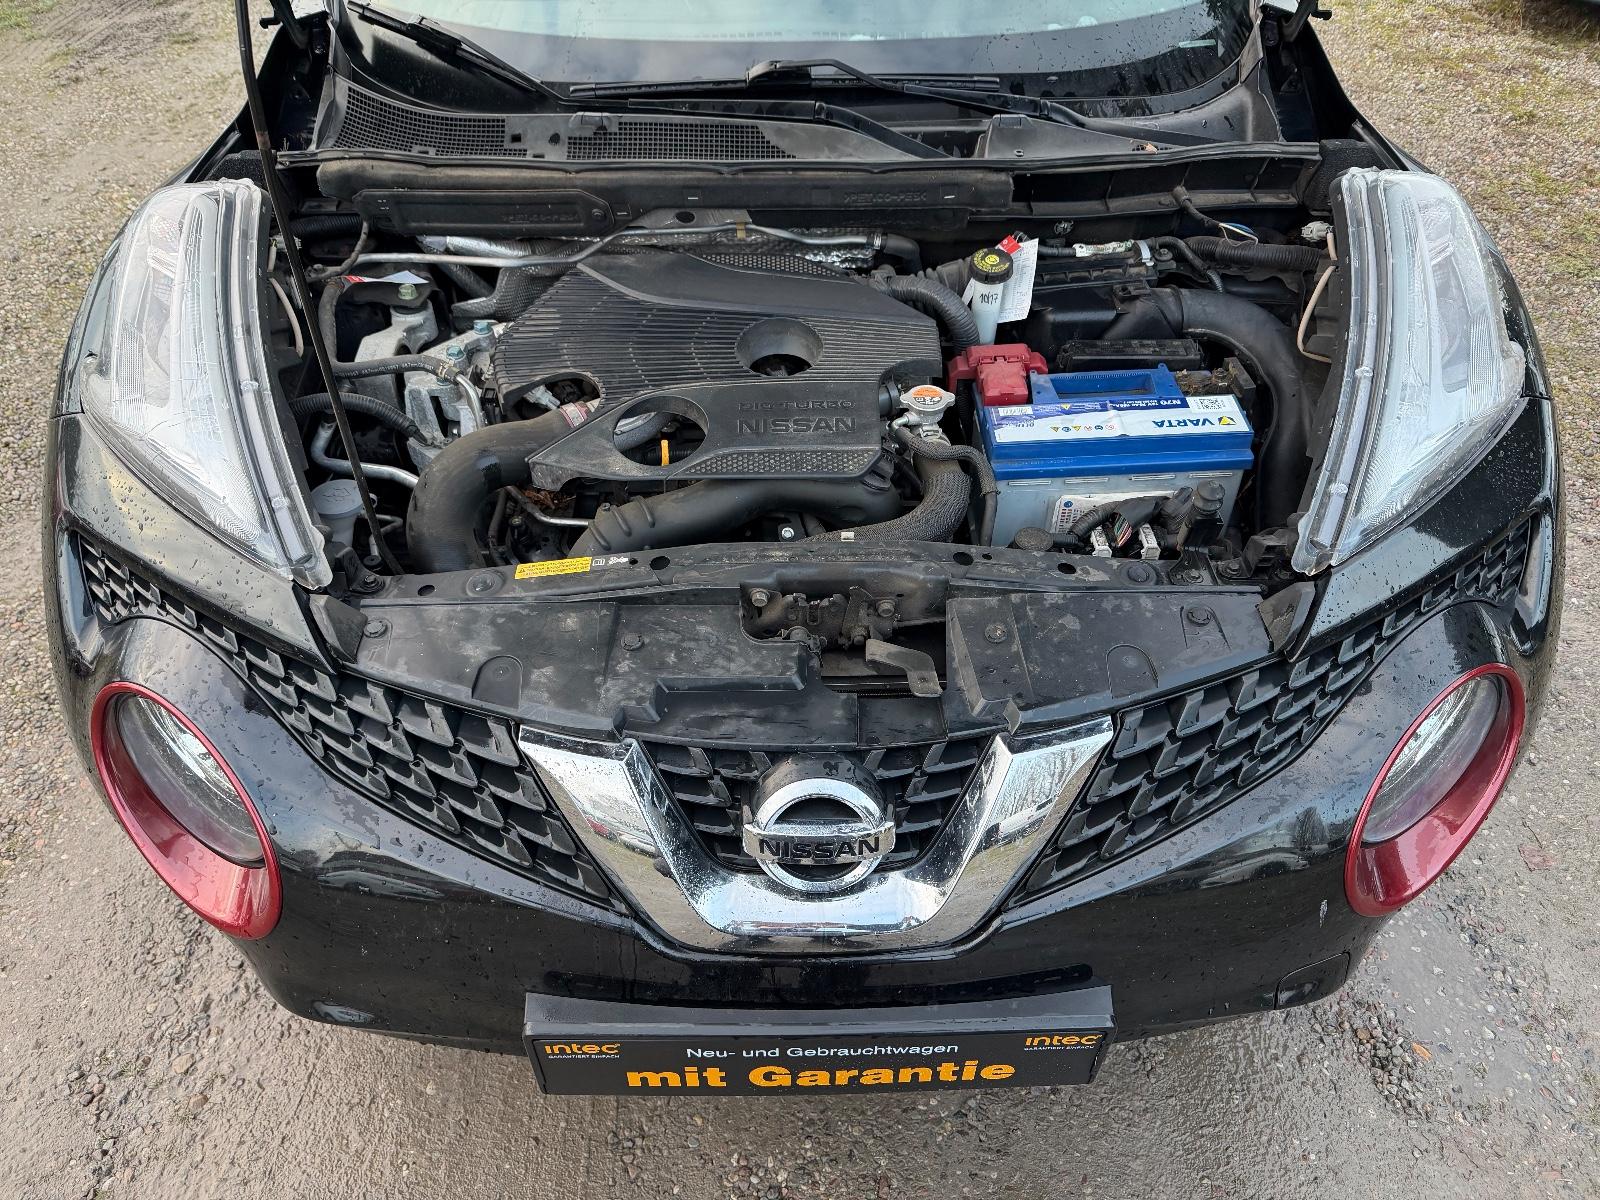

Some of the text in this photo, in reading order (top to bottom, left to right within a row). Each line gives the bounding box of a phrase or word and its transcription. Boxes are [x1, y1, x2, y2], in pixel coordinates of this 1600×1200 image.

[738, 416, 857, 434] NISSAN
[1152, 417, 1215, 428] VARTA
[758, 836, 880, 859] NISSAN
[1025, 1034, 1103, 1046] intec
[544, 1043, 621, 1054] intec
[686, 1045, 959, 1058] Neu- und Gebrauchtwagen
[626, 1060, 1016, 1087] mit Garantie
